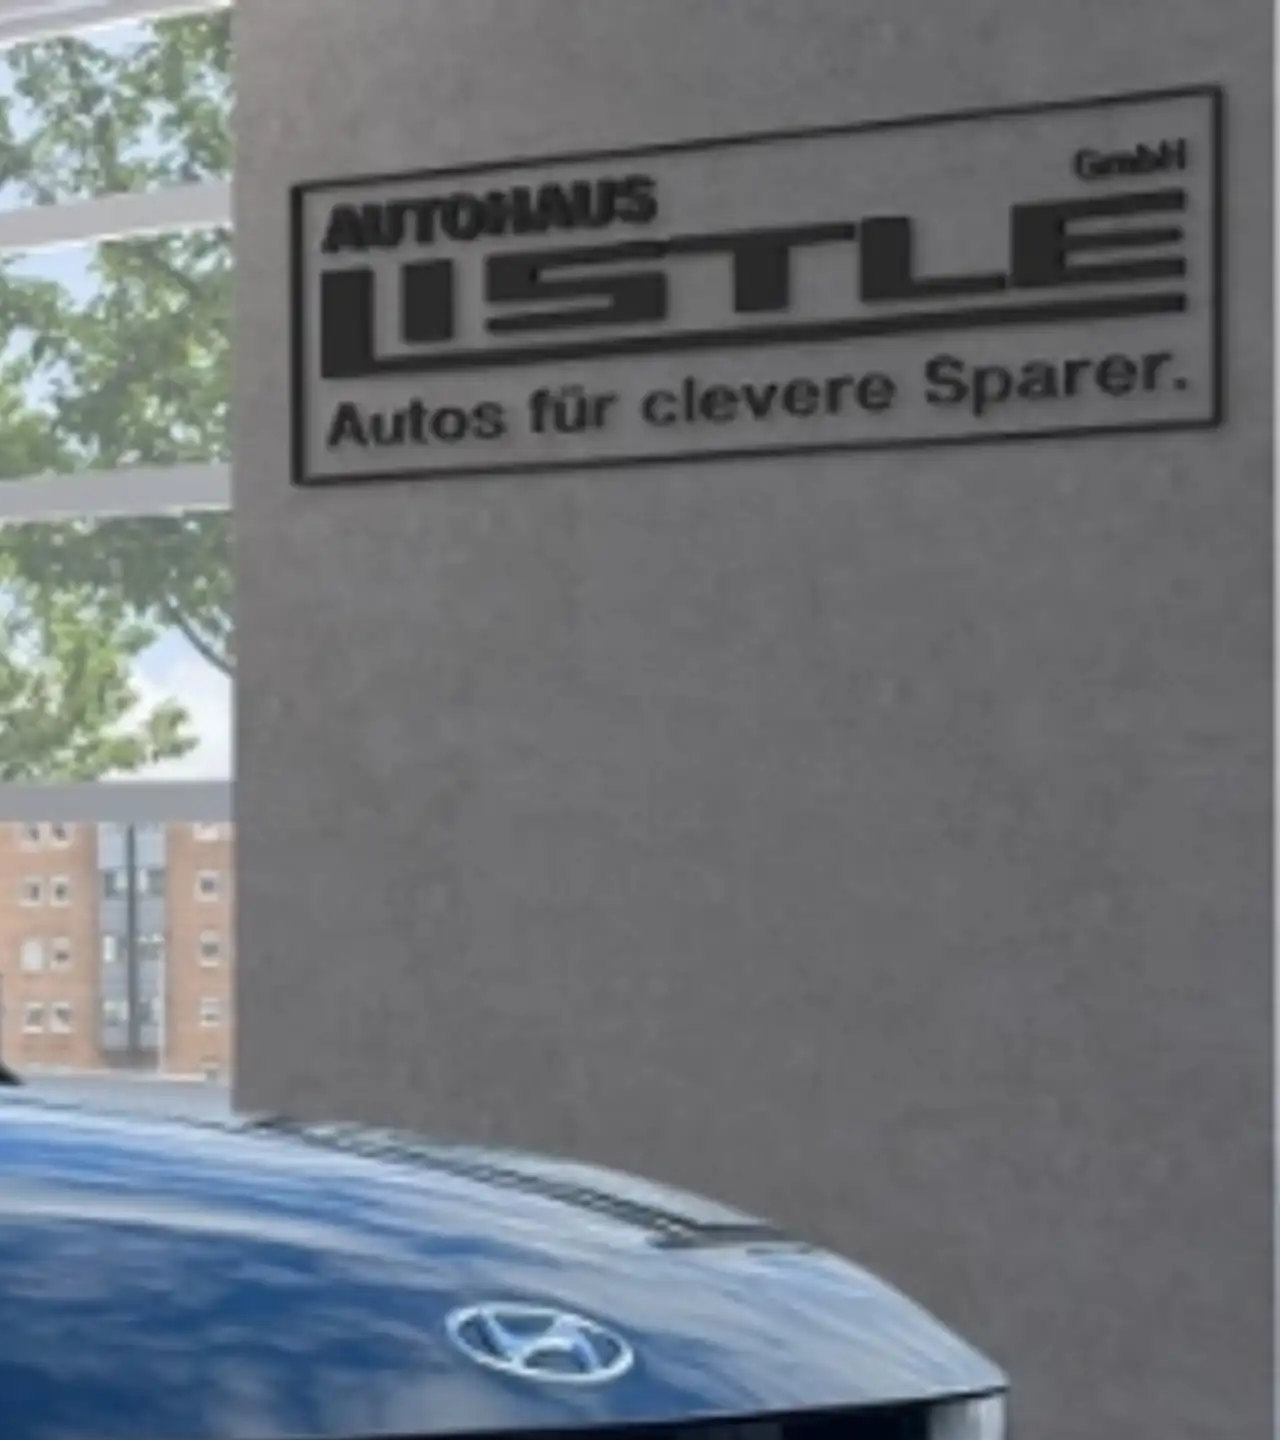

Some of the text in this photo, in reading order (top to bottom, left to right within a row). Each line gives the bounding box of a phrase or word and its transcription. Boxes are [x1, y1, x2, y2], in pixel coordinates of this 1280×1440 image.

[1075, 138, 1188, 181] GmbH
[324, 177, 657, 252] AUTOHAUS
[322, 189, 1186, 378] LISTLE
[326, 348, 1191, 450] Autos für clevere Sparer.
